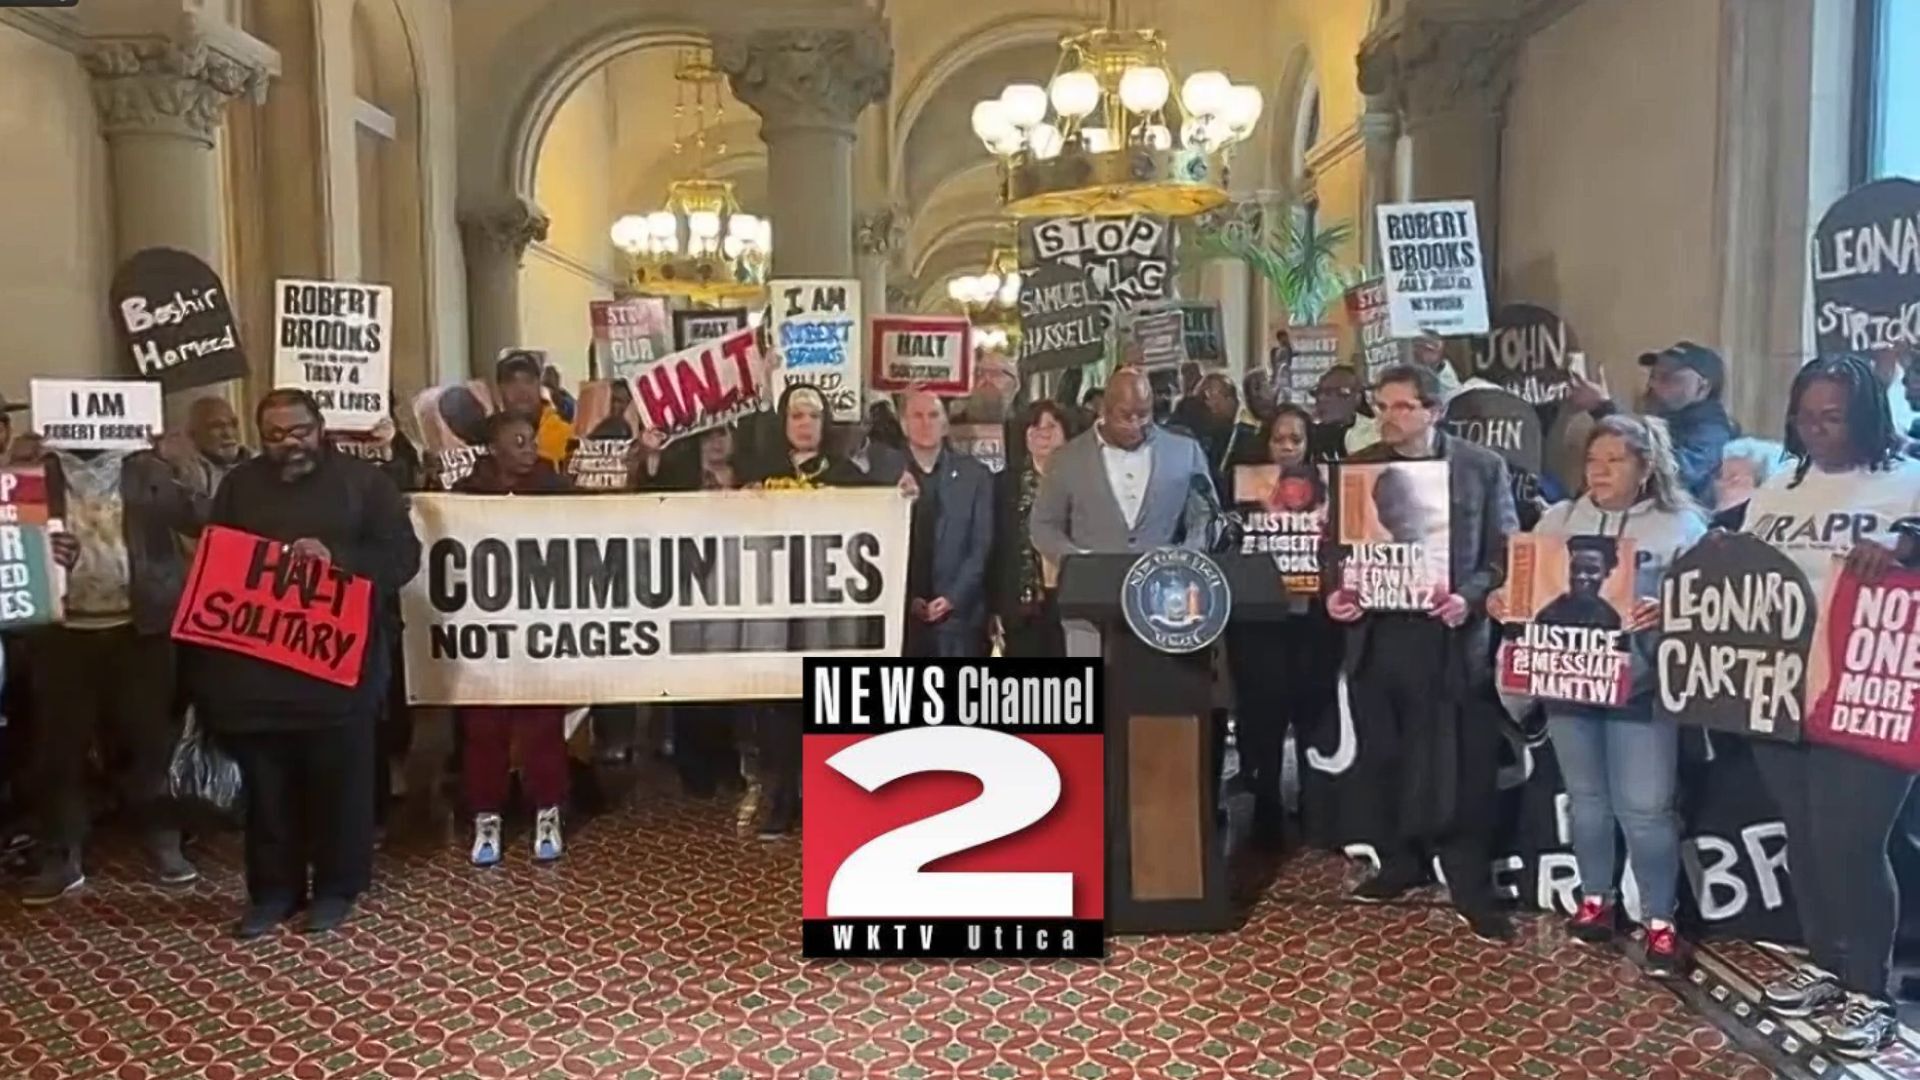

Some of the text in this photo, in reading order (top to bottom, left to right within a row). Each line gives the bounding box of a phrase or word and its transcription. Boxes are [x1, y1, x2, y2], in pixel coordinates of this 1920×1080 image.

[1039, 217, 1155, 253] STOP
[1386, 210, 1468, 240] ROBERT
[1388, 241, 1475, 271] BROOKS
[284, 284, 380, 319] ROBERT
[784, 286, 846, 317] I AM
[281, 316, 381, 353] BROOKS
[897, 333, 947, 358] HALT
[1476, 321, 1566, 373] JOHN
[71, 391, 125, 417] I AM
[1242, 513, 1320, 532] JUSTICE
[1764, 513, 1878, 545] RAPP
[245, 541, 352, 618] HALT
[428, 532, 884, 613] COMMUNITIES
[1664, 569, 1807, 640] LEONARD
[191, 590, 357, 670] SOLITARY
[431, 620, 660, 660] NOT CAGES
[1516, 623, 1622, 657] JUSTICE
[1531, 651, 1620, 681] MESSIAH
[1530, 673, 1617, 705] NANTWI
[1658, 638, 1803, 733] CARTER
[1837, 672, 1920, 712] MORE
[1831, 704, 1913, 742] DEATH
